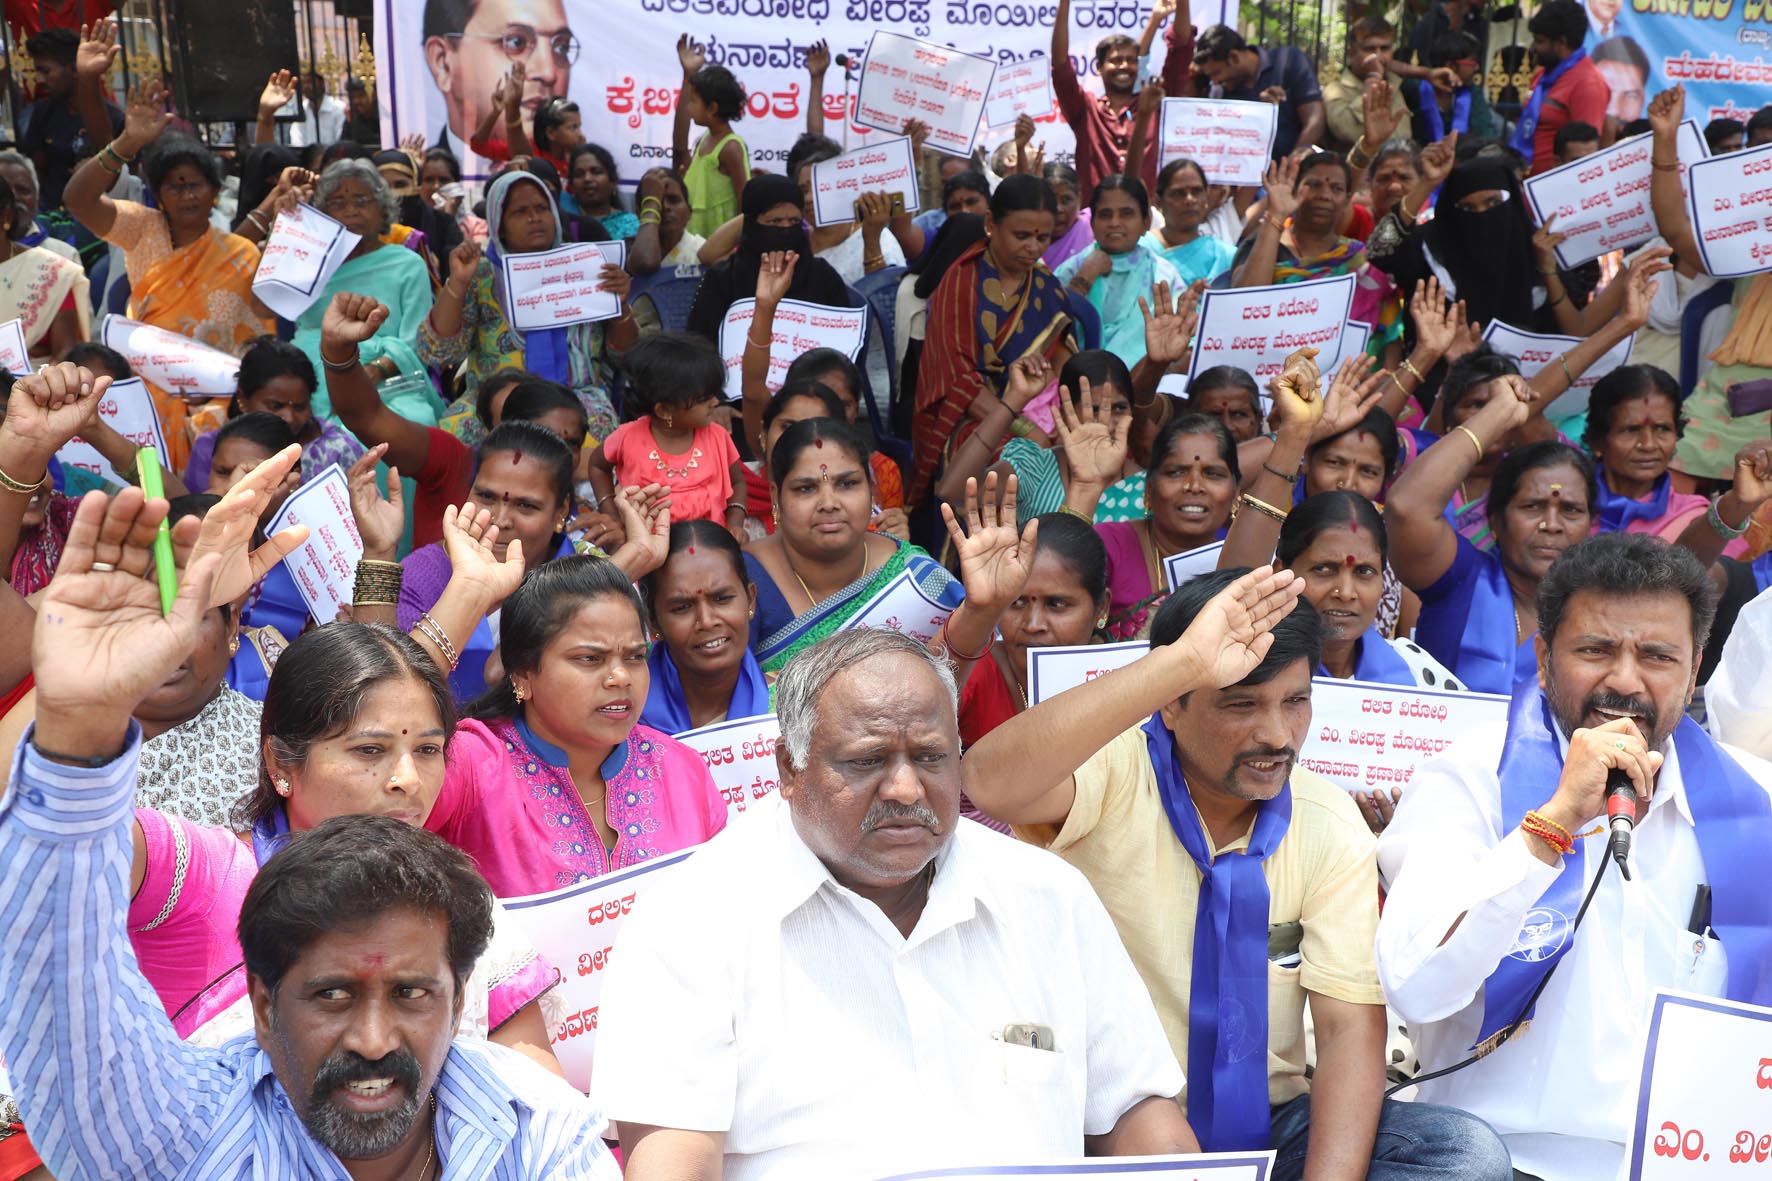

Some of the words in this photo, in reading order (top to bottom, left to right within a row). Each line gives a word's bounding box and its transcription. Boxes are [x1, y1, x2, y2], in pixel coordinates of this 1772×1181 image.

[1577, 164, 1604, 184] ದಲಿತ
[1608, 147, 1648, 172] ವಿರೋಧಿ
[1713, 198, 1734, 212] ಎಂ.
[1242, 304, 1271, 320] ದಲಿತ
[1277, 297, 1319, 318] ವಿರೋಧಿ
[1203, 336, 1224, 351] ಎಂ.
[1231, 334, 1267, 356] ವೀರಪ್ಪ
[1520, 350, 1552, 363] ದಲಿತ
[1362, 699, 1393, 716] ದಲಿತ
[1399, 698, 1448, 723] ವಿರೋಧಿ
[1320, 726, 1342, 743] ಎಂ.
[1349, 728, 1386, 755] ವೀರಪ್ಪ
[1300, 756, 1359, 779] ಚುನಾವಣಾ
[1366, 764, 1415, 786] ಪ್ರಣಾಳಿಕೆ
[720, 785, 747, 812] ರಪ್ಪ
[1653, 1120, 1710, 1162] ಎಂ.
